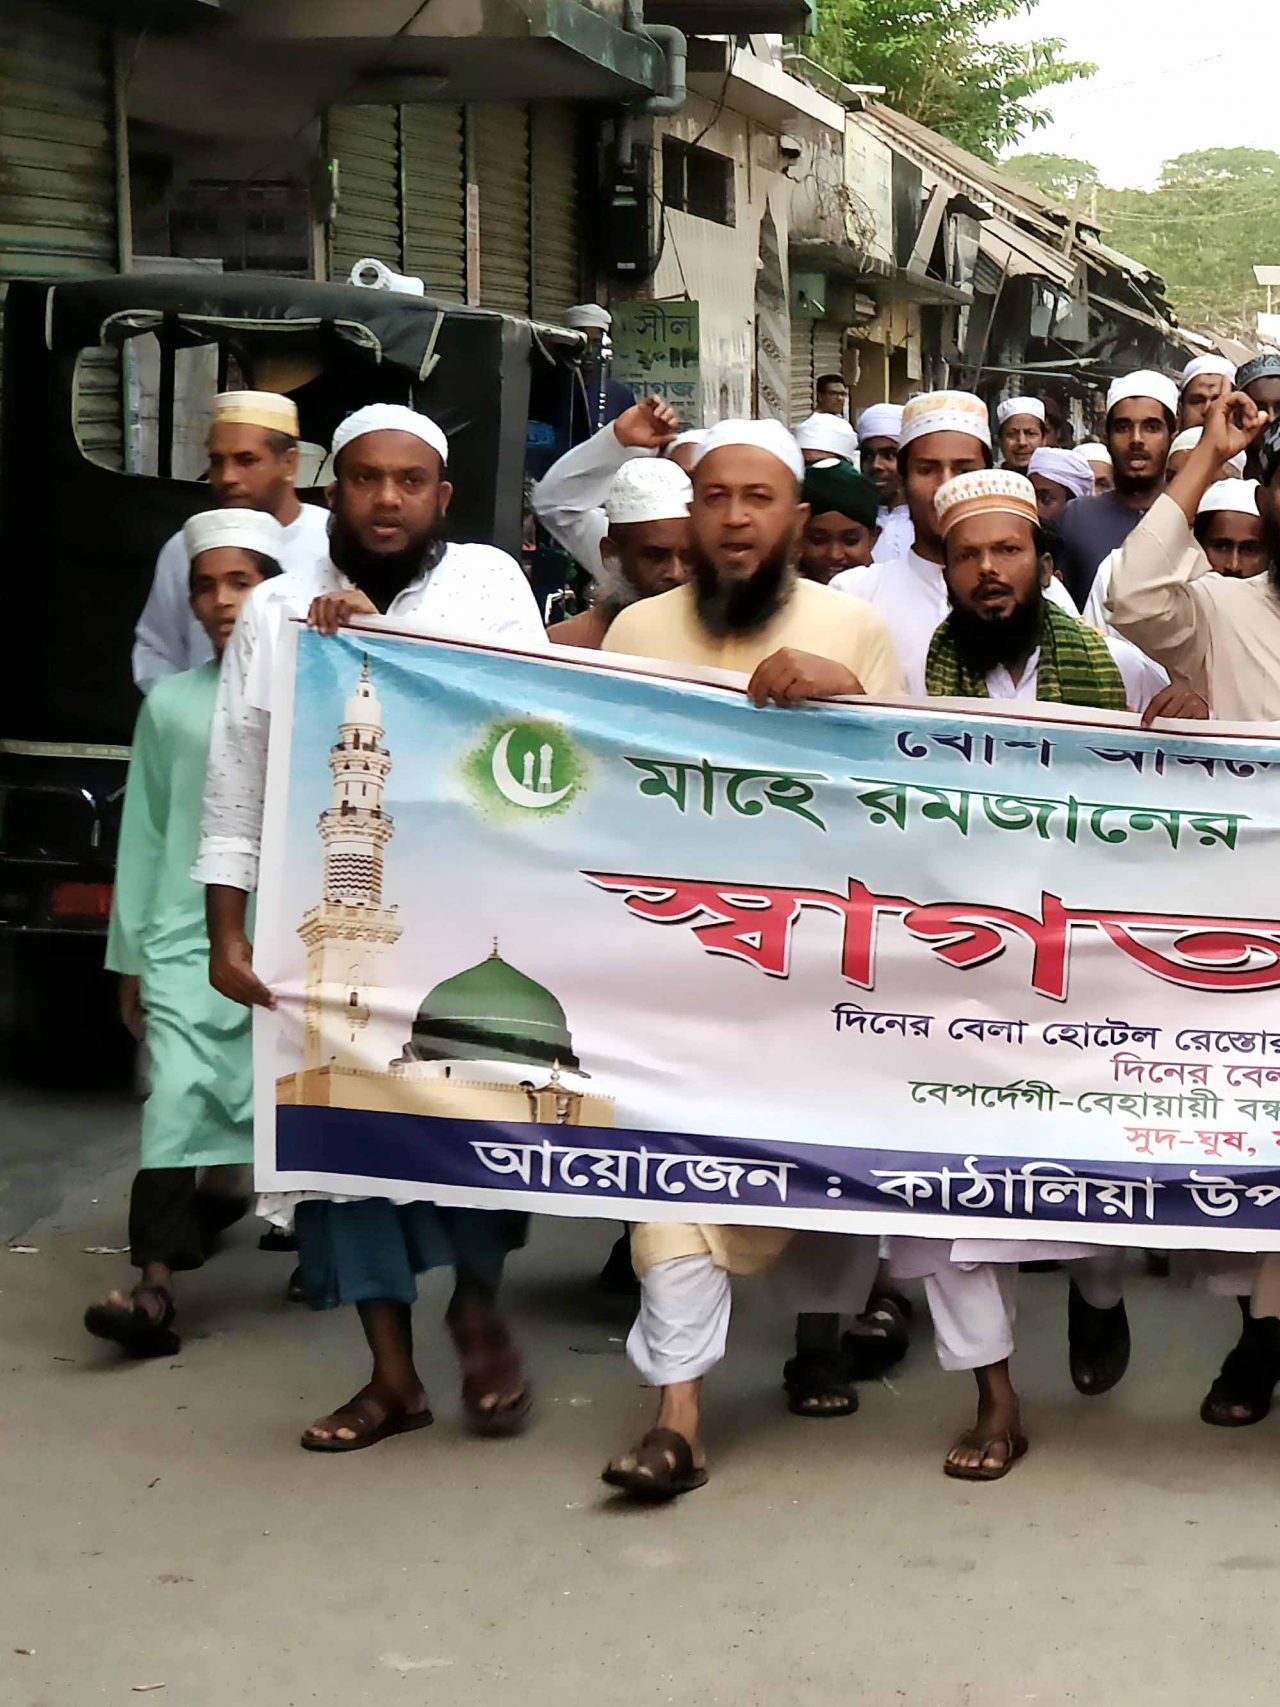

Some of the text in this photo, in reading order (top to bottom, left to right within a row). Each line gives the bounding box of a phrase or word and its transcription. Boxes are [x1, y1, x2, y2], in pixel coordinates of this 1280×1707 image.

[625, 755, 832, 832] মাহে
[849, 776, 1252, 851] রমজানের
[831, 1002, 936, 1039] দিনের
[949, 1018, 1030, 1045] বেলা
[1042, 1017, 1163, 1050] হোটেল
[1109, 1052, 1213, 1087] দিনের
[1123, 1126, 1256, 1157] সুদ-ঘুষ,
[871, 1155, 1166, 1221] কাঠালিয়া
